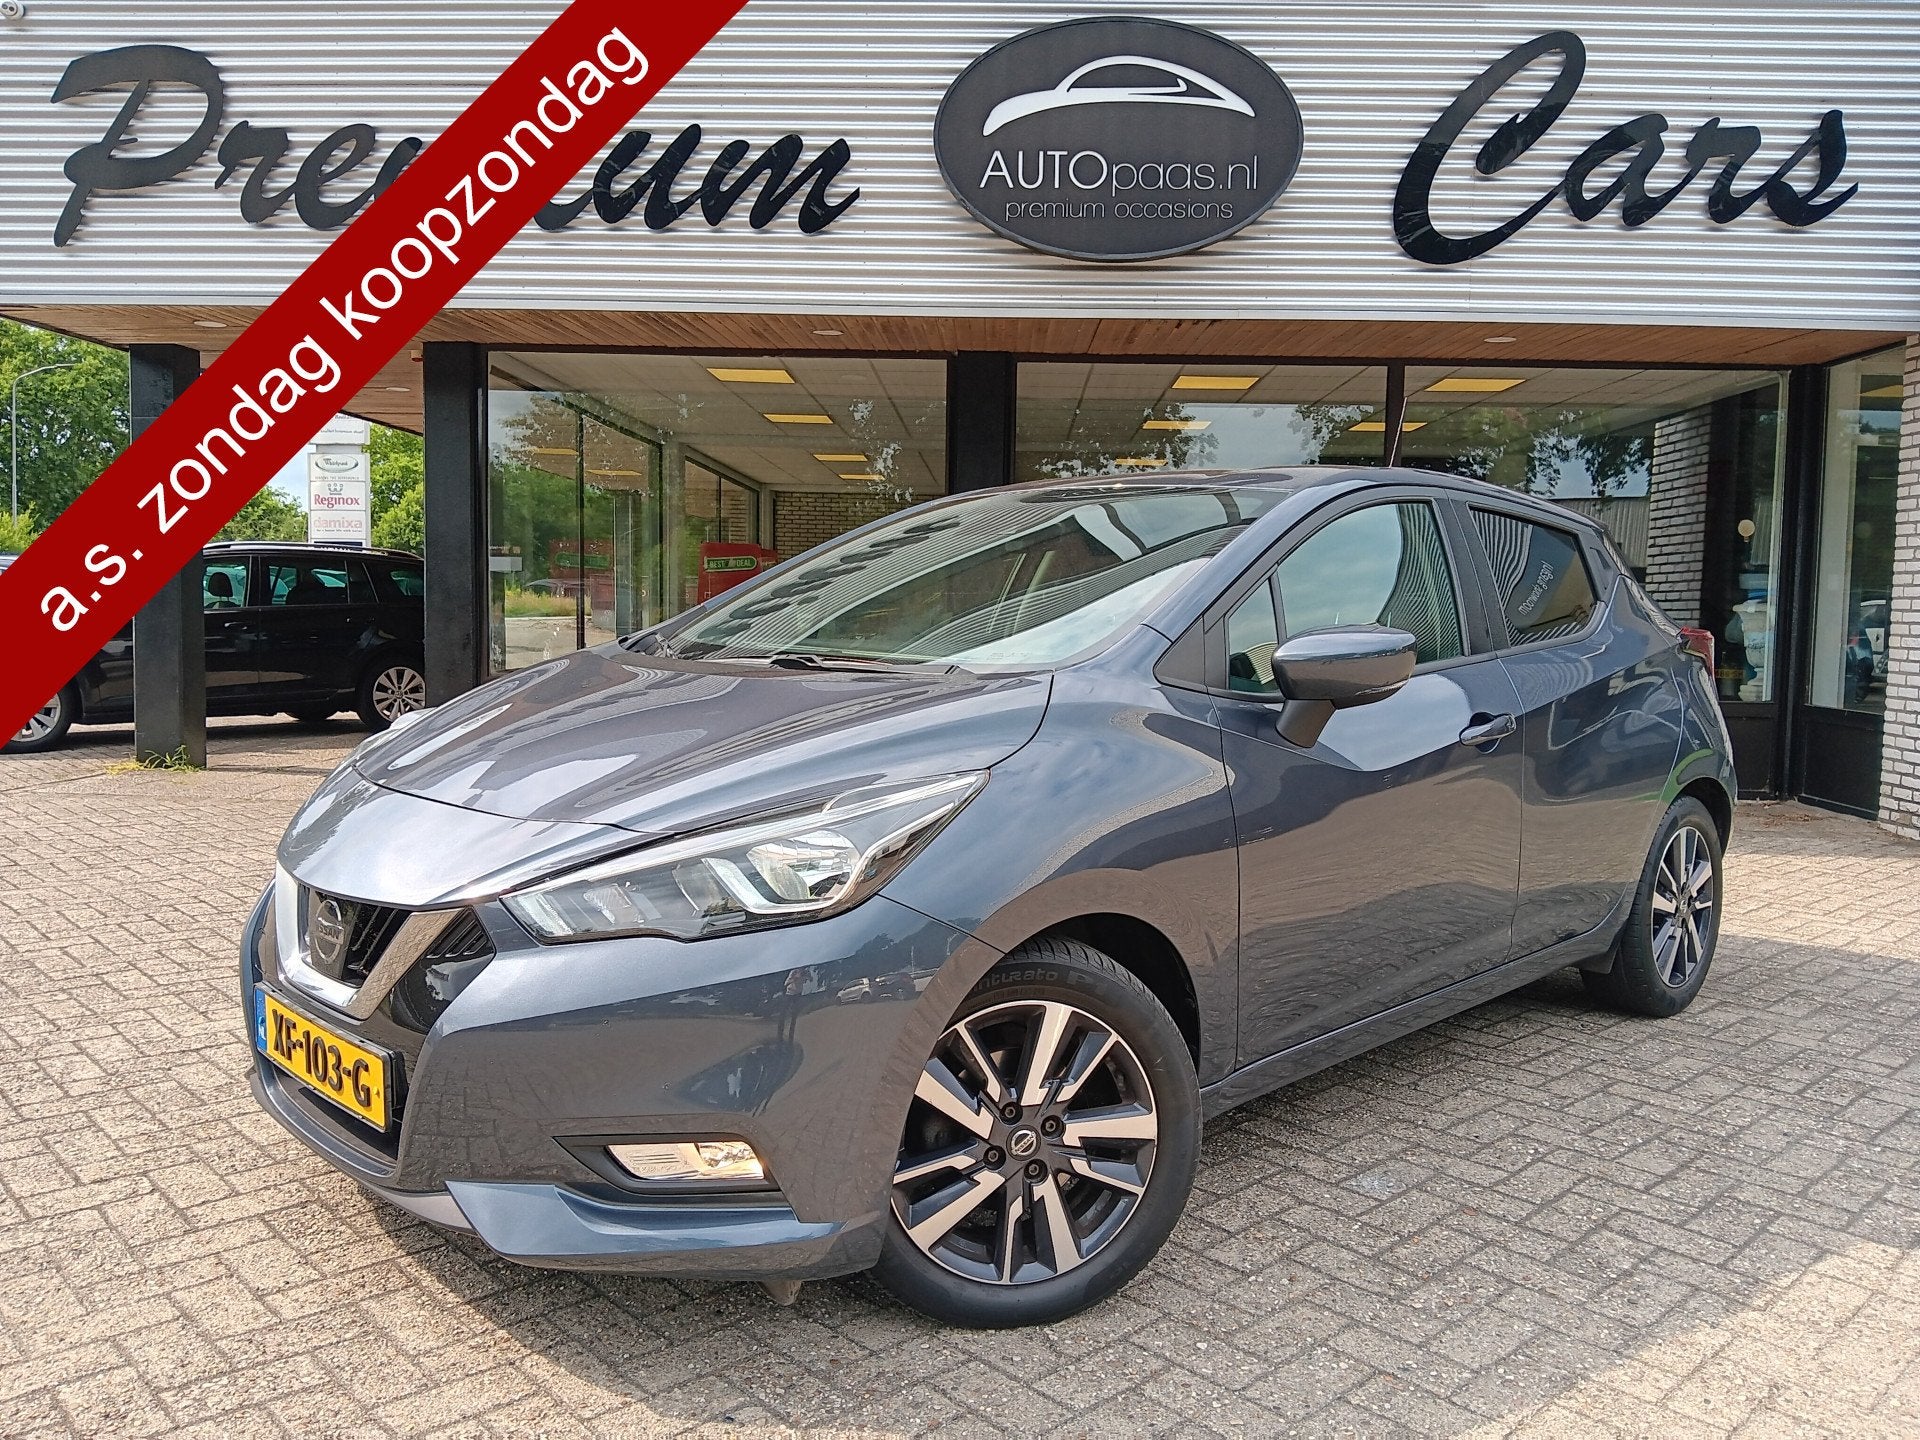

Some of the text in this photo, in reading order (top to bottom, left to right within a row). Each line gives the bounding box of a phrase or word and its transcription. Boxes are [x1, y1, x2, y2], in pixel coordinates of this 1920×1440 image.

[50, 30, 1859, 265] Preum Cars
[979, 149, 1259, 198] AUTOpaas.nl
[1005, 198, 1234, 222] premium occasions
[314, 494, 360, 509] Reginox
[313, 517, 363, 529] damixa
[709, 559, 752, 569] BEST DEAL
[271, 1008, 371, 1107] XF-103-G
